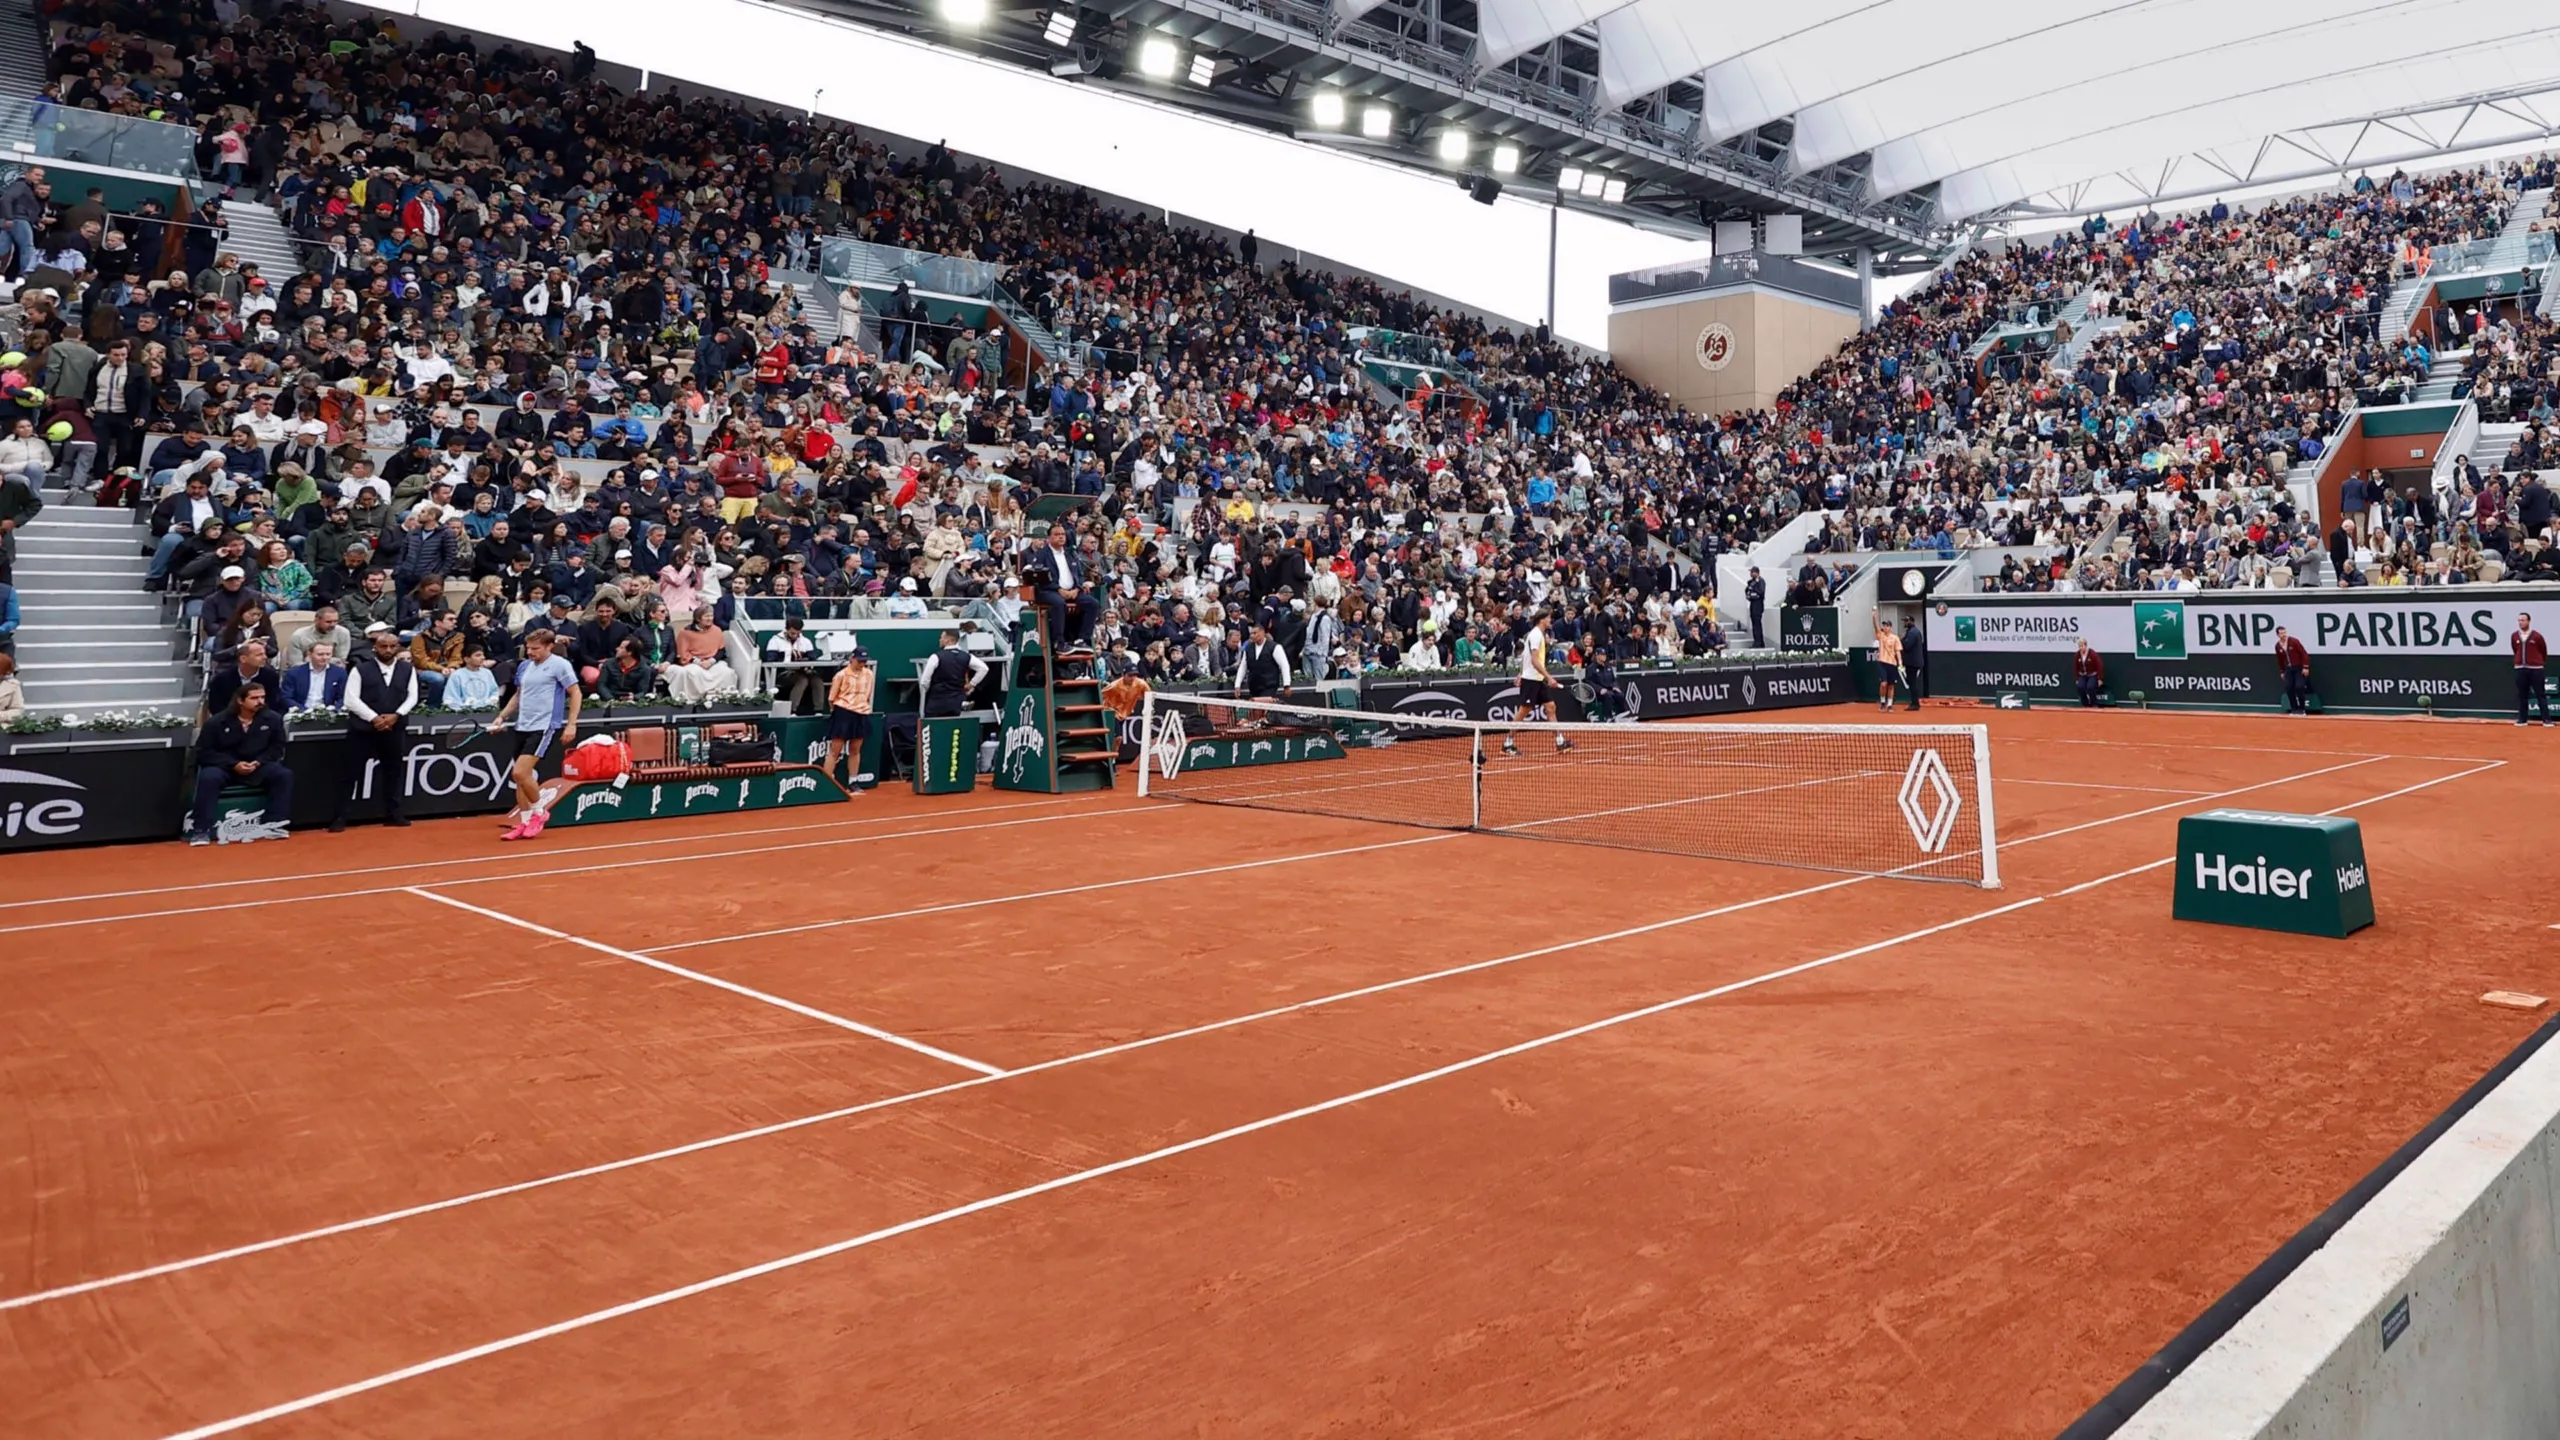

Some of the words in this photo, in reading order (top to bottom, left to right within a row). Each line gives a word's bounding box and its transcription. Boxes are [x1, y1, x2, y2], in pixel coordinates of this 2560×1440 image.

[1981, 617, 2011, 632] BNP
[2015, 616, 2079, 633] PARIBAS
[2197, 613, 2275, 646] BNP
[2316, 610, 2497, 647] PARIBAS
[1785, 633, 1830, 646] ROLEX
[1768, 677, 1832, 696] RENAULT
[1976, 672, 2002, 686] BNP
[2005, 673, 2060, 687] PARIBAS
[2154, 675, 2184, 690] BNP
[2188, 676, 2251, 692] PARIBAS
[2360, 678, 2394, 694] BNP
[2398, 679, 2472, 696] PARIBAS
[1656, 683, 1731, 704] RENAULT
[2195, 852, 2313, 900] Haier
[2336, 862, 2366, 894] Haier
